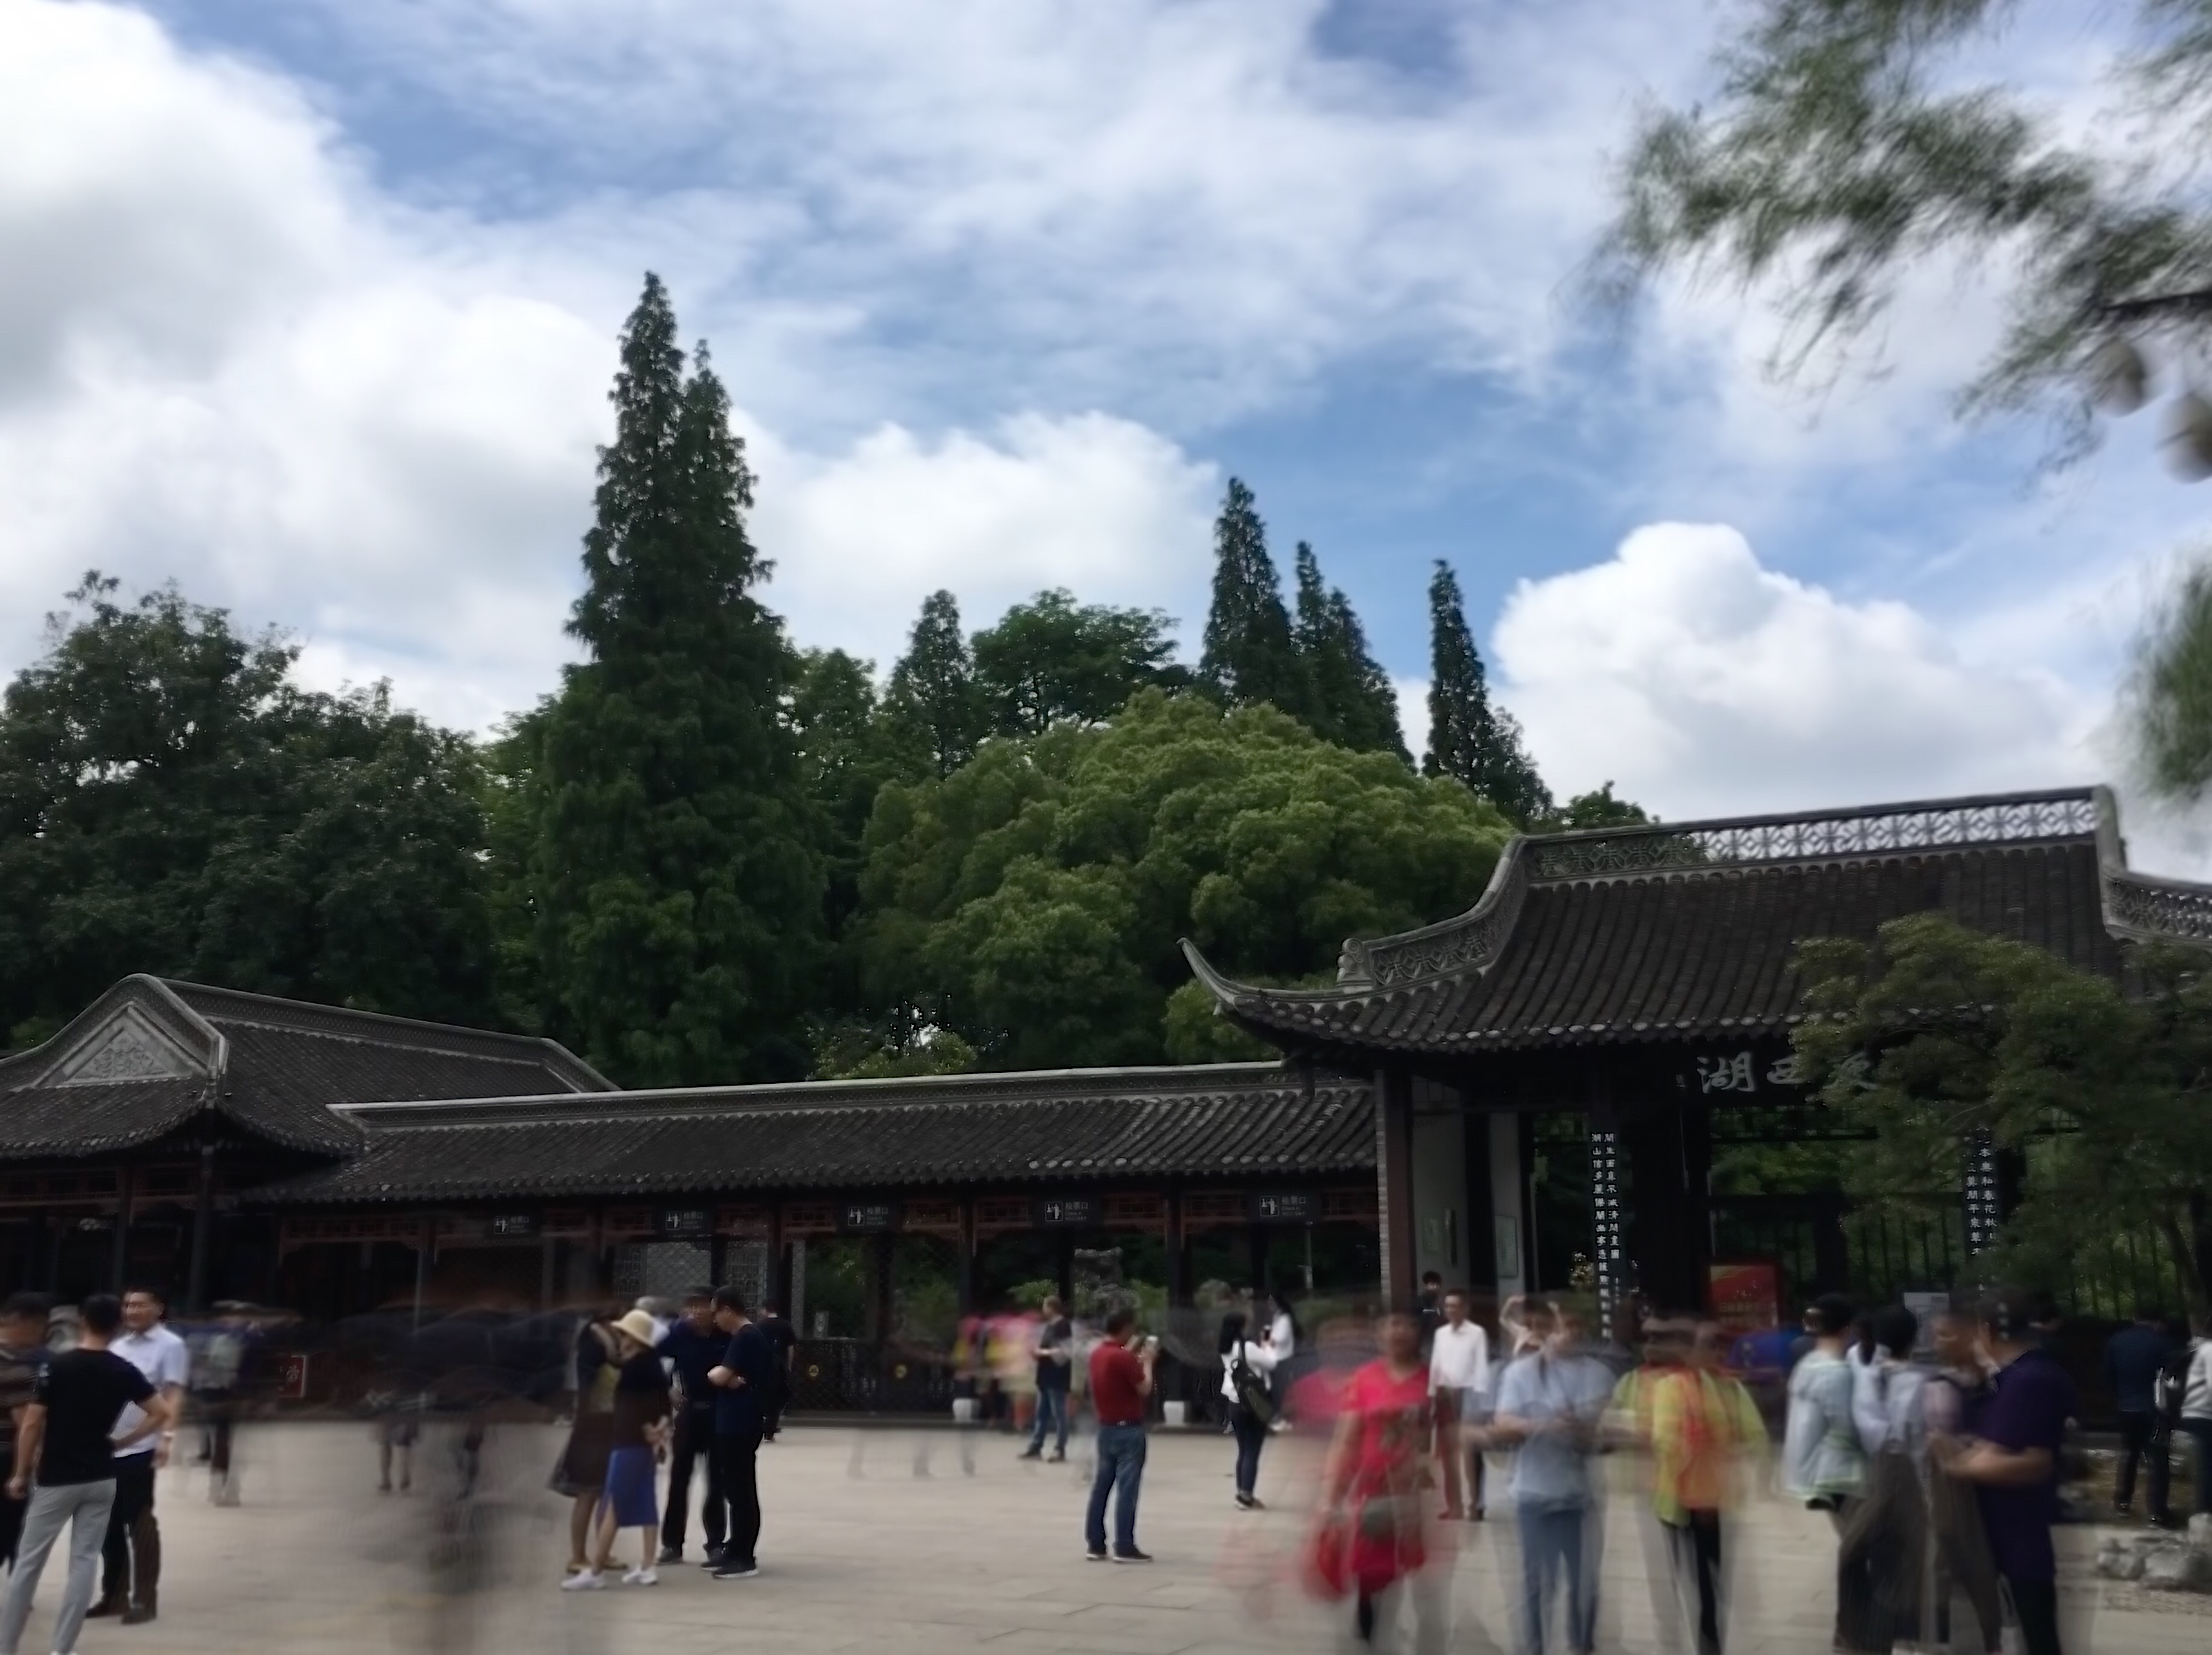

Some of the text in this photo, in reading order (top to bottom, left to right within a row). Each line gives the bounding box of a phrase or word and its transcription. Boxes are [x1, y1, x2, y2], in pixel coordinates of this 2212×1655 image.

[1065, 1201, 1088, 1210] 检票口
[867, 1206, 888, 1215] 检票口
